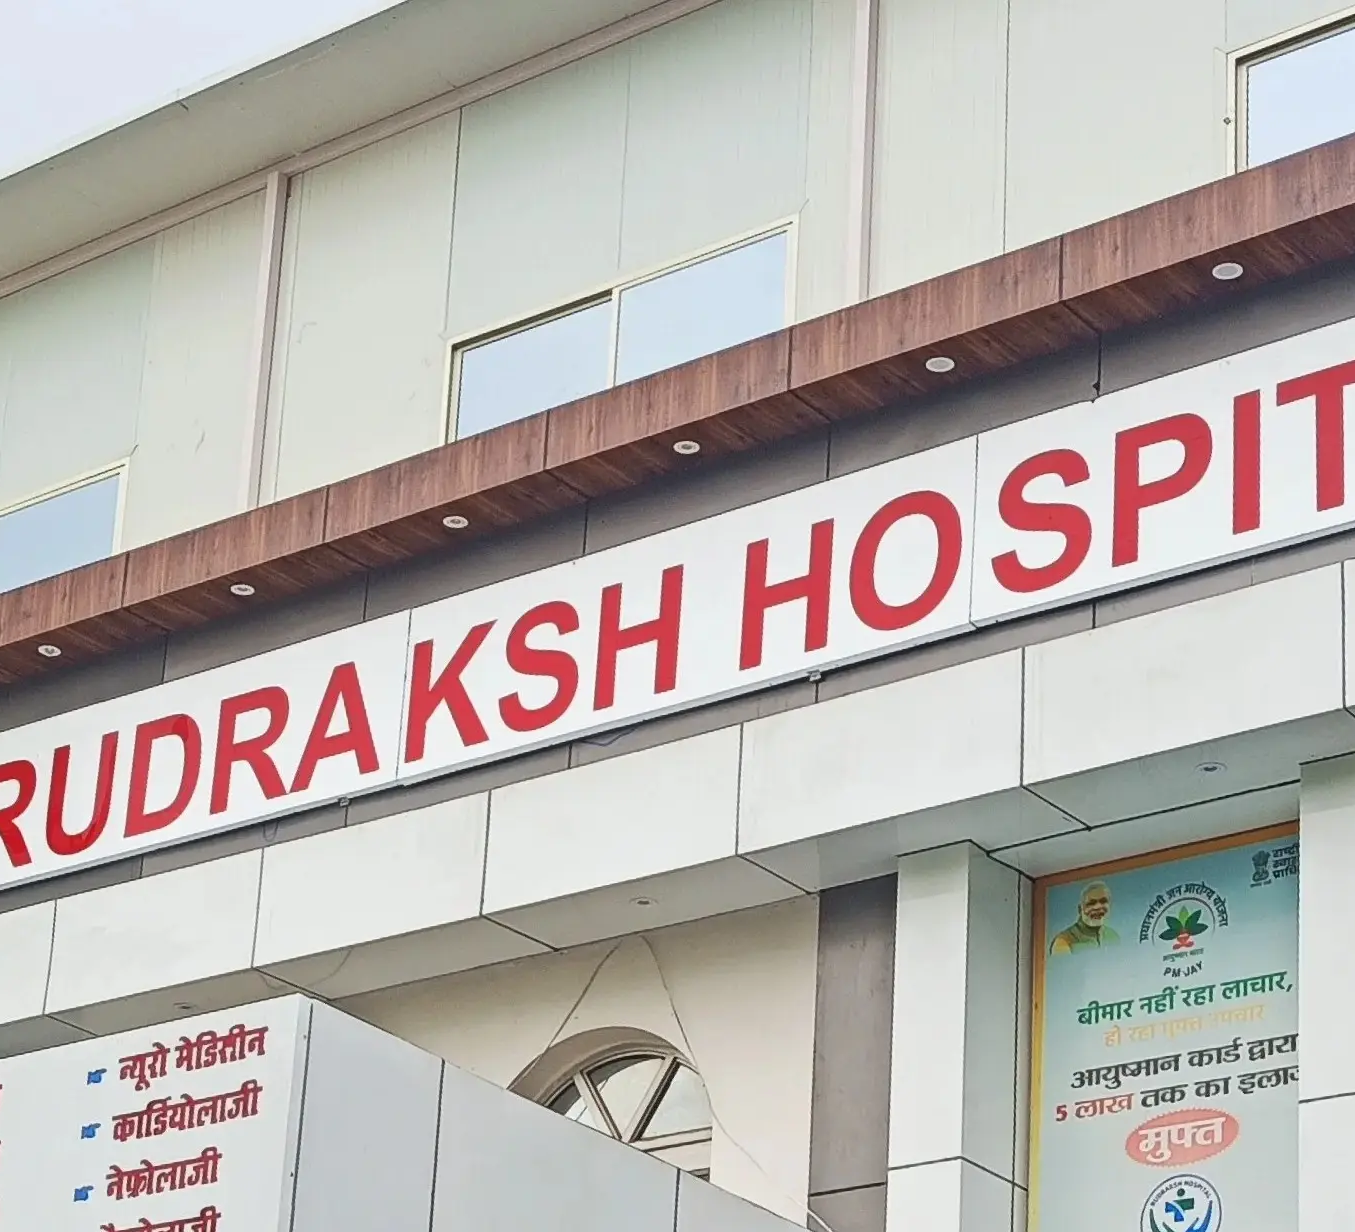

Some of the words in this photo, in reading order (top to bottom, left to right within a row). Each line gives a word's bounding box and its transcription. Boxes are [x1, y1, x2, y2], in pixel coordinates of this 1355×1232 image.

[1077, 1000, 1134, 1026] बीमार
[1139, 984, 1180, 1016] नहीं
[1182, 984, 1215, 1008] रहा
[1220, 971, 1294, 1000] लाचार,
[119, 1042, 170, 1091] न्यूरो
[1071, 1054, 1182, 1090] आयुष्मान
[1188, 1037, 1243, 1068] कार्ड
[1247, 1032, 1298, 1060] द्वारा
[112, 1080, 262, 1142] कार्डियोलाजी
[1055, 1104, 1068, 1122] 5
[1075, 1093, 1135, 1119] लाख
[1140, 1083, 1188, 1109] तक
[1195, 1076, 1232, 1098] का
[1138, 1117, 1227, 1163] मुफ्त
[107, 1147, 222, 1200] नेफ्रोलाजी
